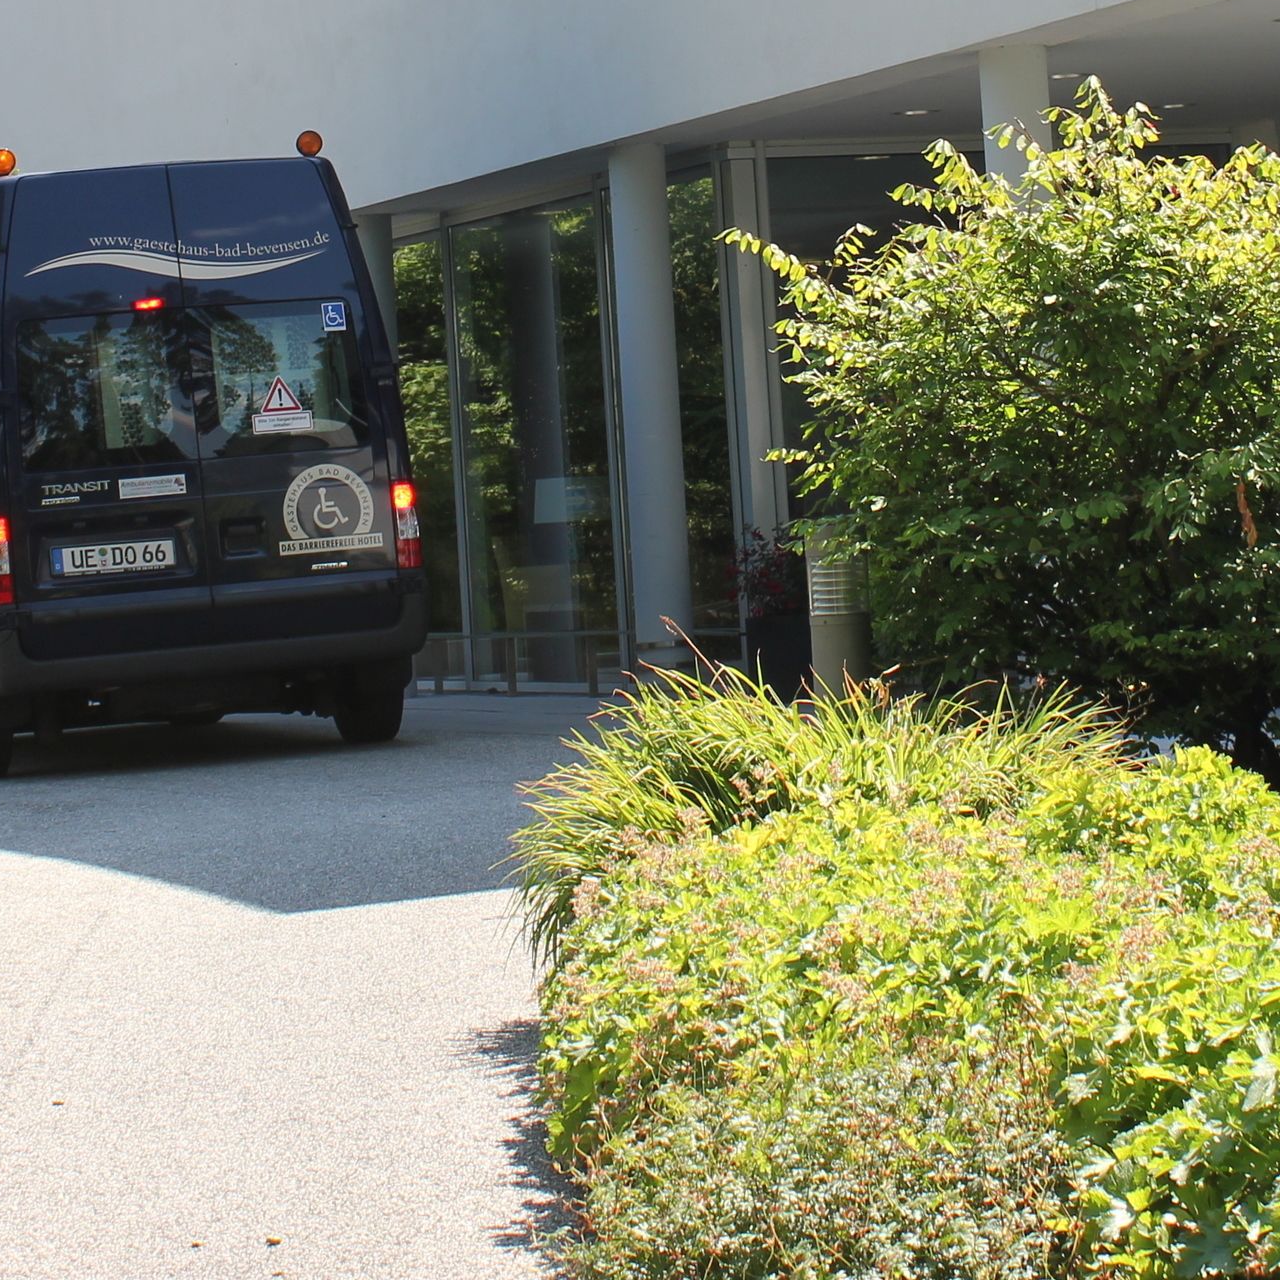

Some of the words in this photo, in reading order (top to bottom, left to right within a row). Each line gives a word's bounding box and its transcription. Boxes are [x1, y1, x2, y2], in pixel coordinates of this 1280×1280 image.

[89, 231, 330, 257] www.gaestehaus-bad-bevensen.de
[41, 480, 110, 495] TRANSIT
[318, 468, 340, 477] BAD
[344, 473, 371, 527] BEVENSEN
[71, 549, 96, 568] UE
[111, 545, 136, 565] DO
[142, 543, 166, 563] 66
[281, 543, 297, 553] DAS
[299, 539, 355, 551] BARRIEREFREIE
[357, 535, 382, 545] HOTEL
